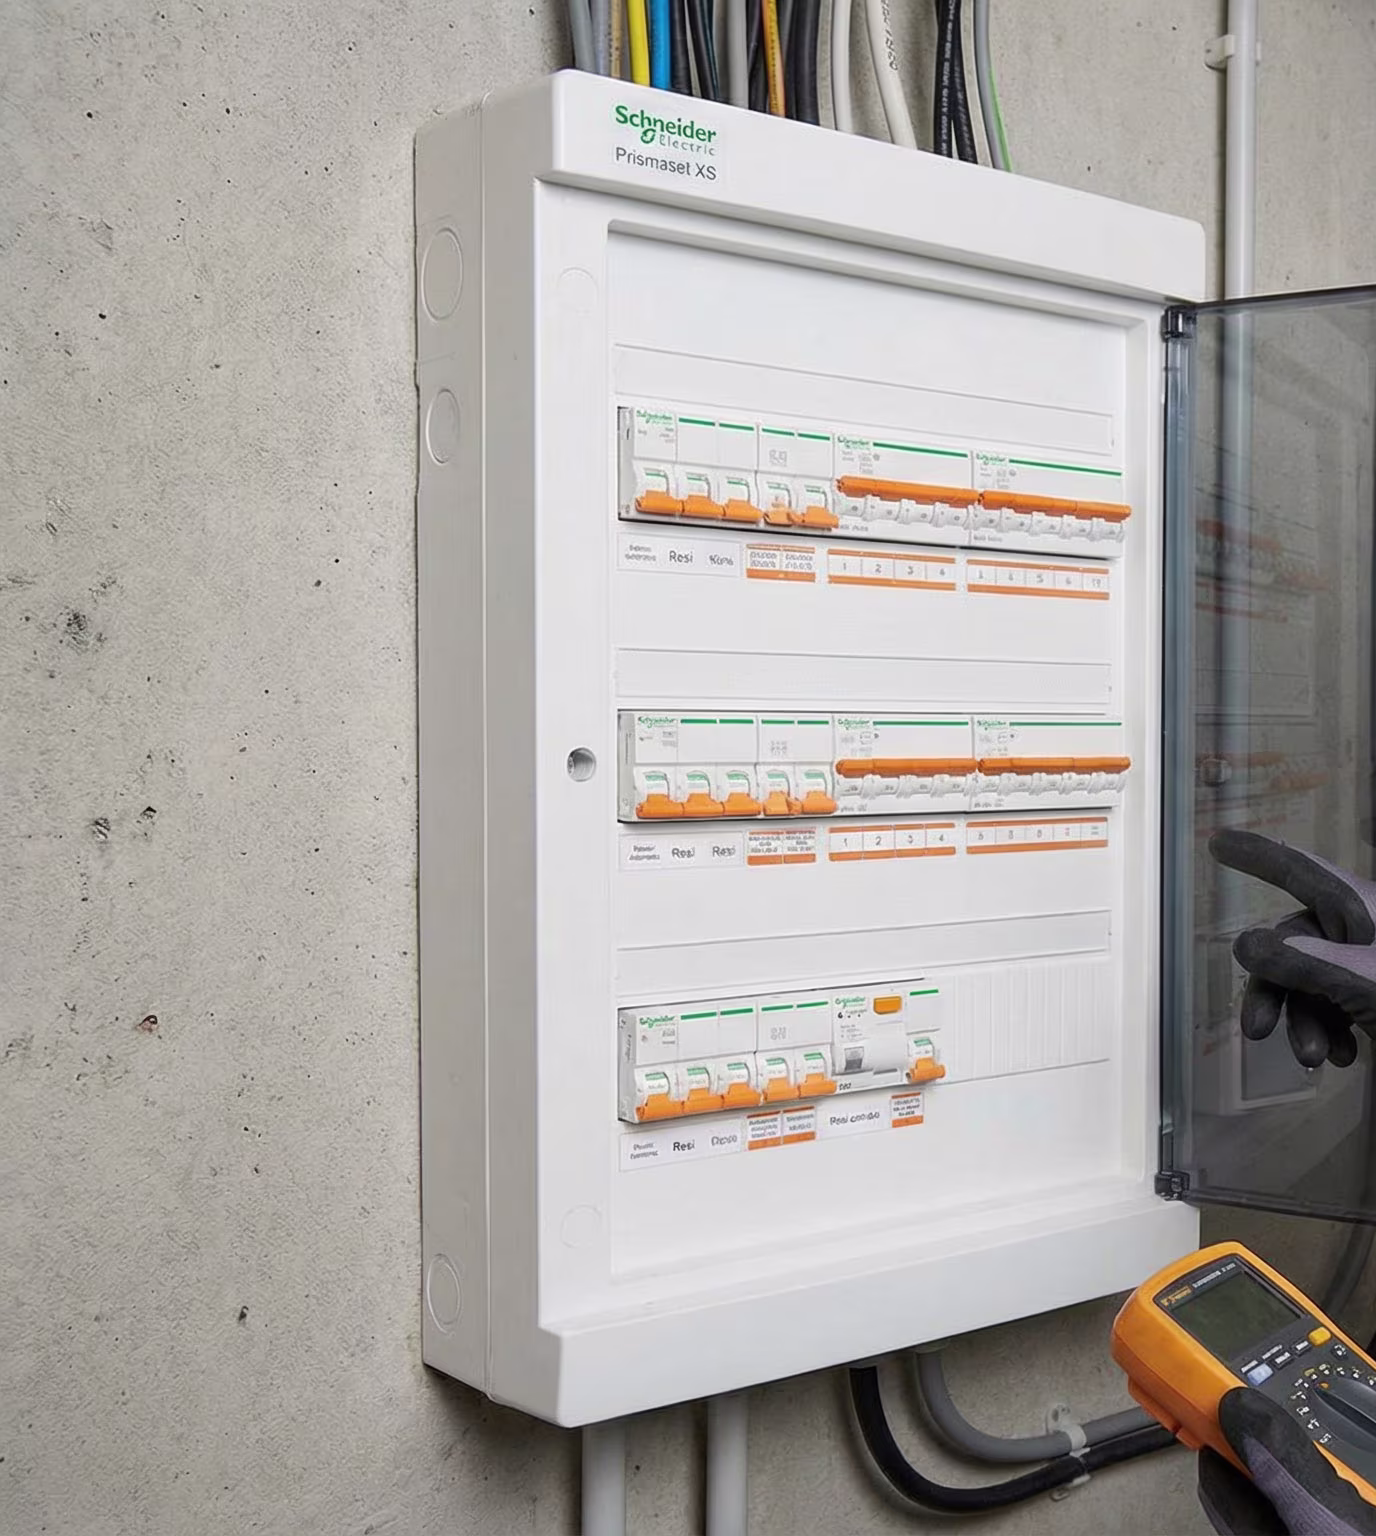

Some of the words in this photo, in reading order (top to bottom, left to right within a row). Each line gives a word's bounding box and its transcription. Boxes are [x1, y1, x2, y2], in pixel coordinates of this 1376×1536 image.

[615, 105, 717, 143] Schneider
[659, 134, 716, 156] Electric
[615, 146, 691, 176] Prismaset
[695, 162, 717, 181] XS
